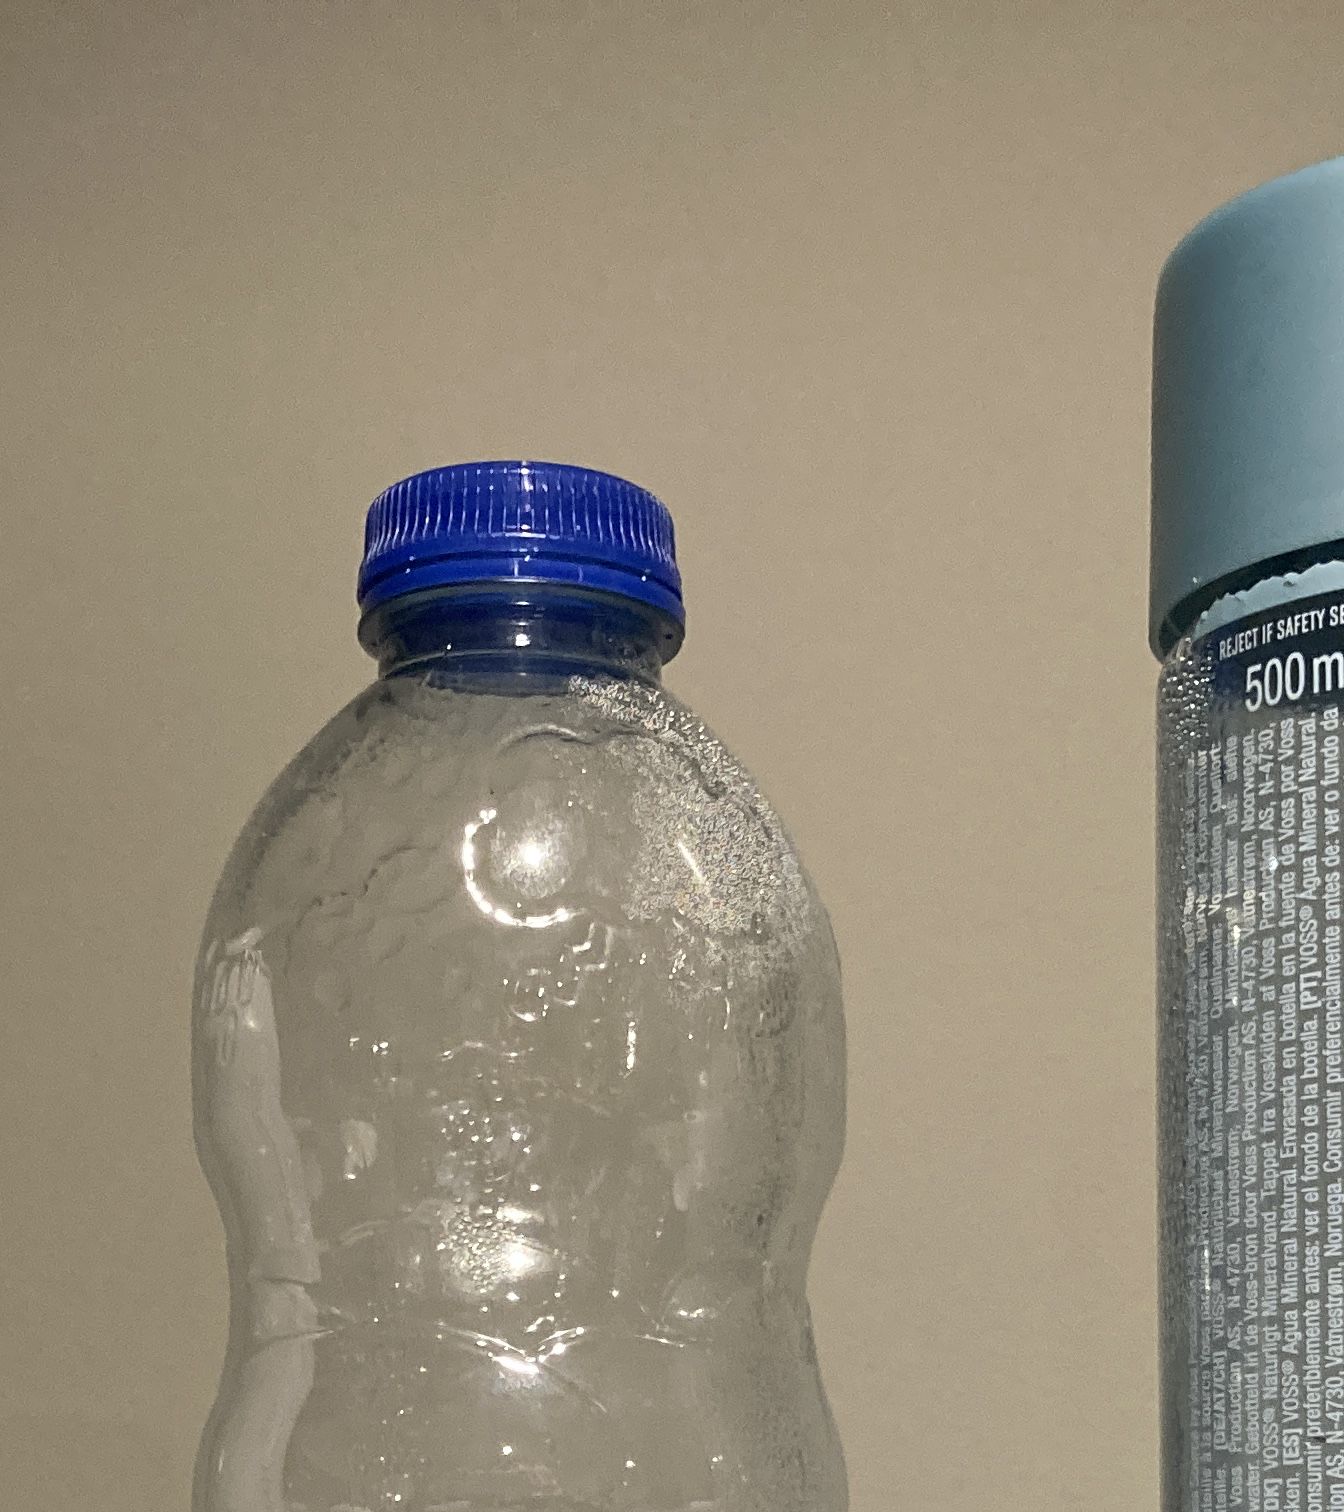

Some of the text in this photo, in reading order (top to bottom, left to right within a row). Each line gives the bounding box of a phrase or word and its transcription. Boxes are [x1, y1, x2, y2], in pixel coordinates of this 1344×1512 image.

[1218, 627, 1257, 662] REJECT
[1262, 622, 1274, 645] IF
[1277, 608, 1326, 640] SAFETY
